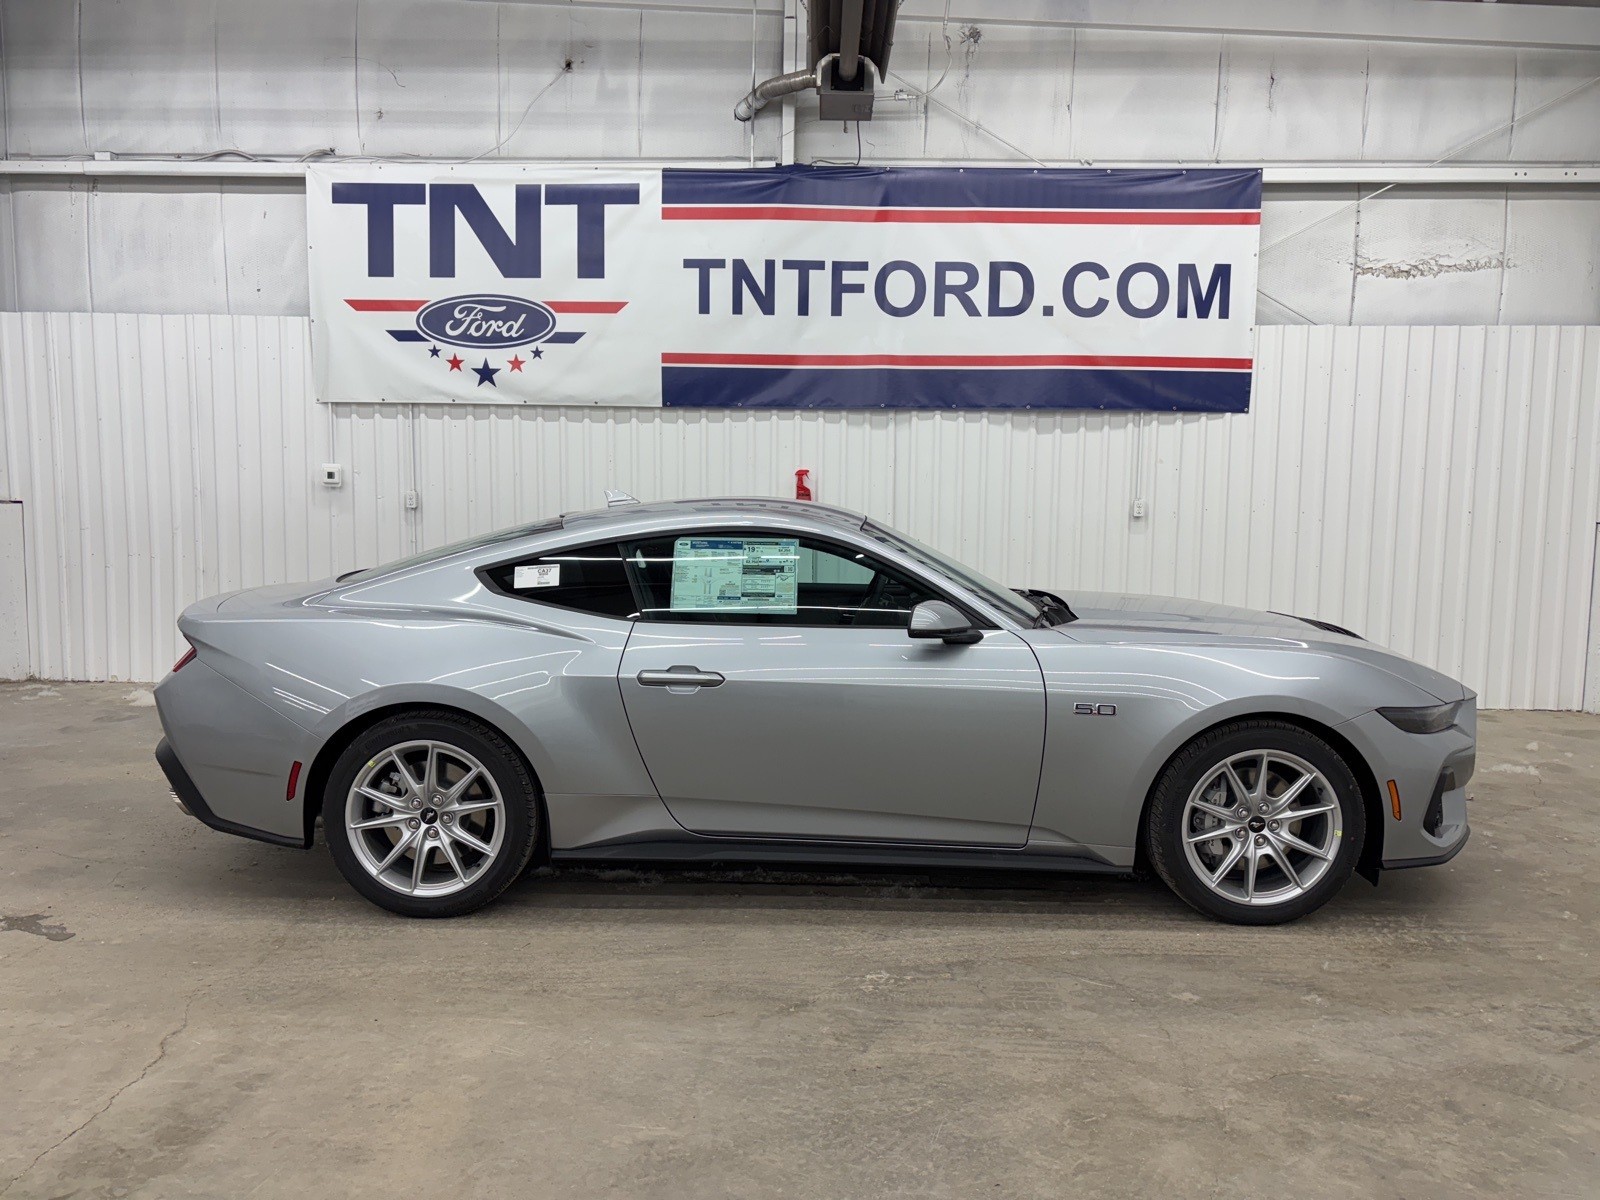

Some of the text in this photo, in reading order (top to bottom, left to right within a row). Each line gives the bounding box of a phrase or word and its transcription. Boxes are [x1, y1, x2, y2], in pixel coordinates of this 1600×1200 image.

[332, 182, 640, 279] TNT
[682, 257, 1232, 320] TNTFORD.COM
[445, 303, 526, 338] Ford
[1073, 702, 1117, 716] 5.0
